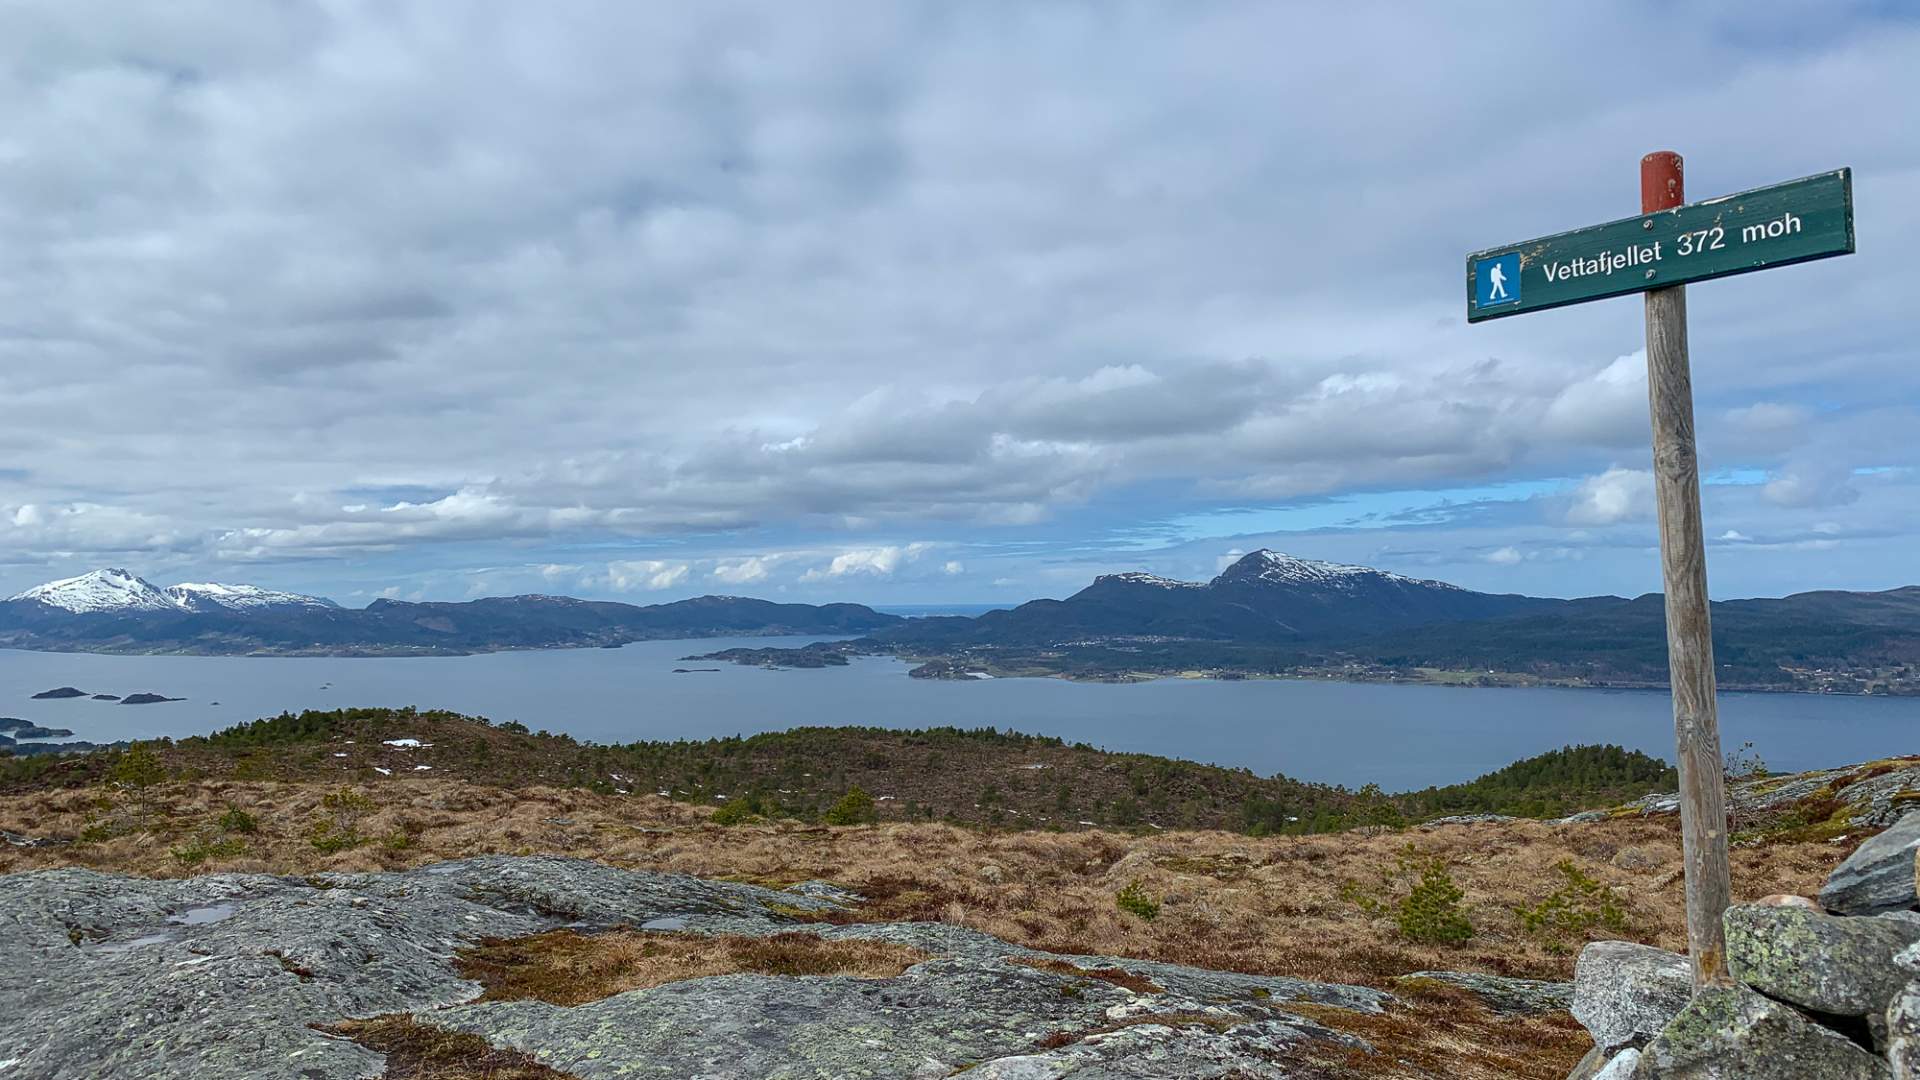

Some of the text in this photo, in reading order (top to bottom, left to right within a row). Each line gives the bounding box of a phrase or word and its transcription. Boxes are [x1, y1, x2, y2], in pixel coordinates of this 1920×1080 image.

[1543, 212, 1801, 282] Vettafjellet 372 moh
